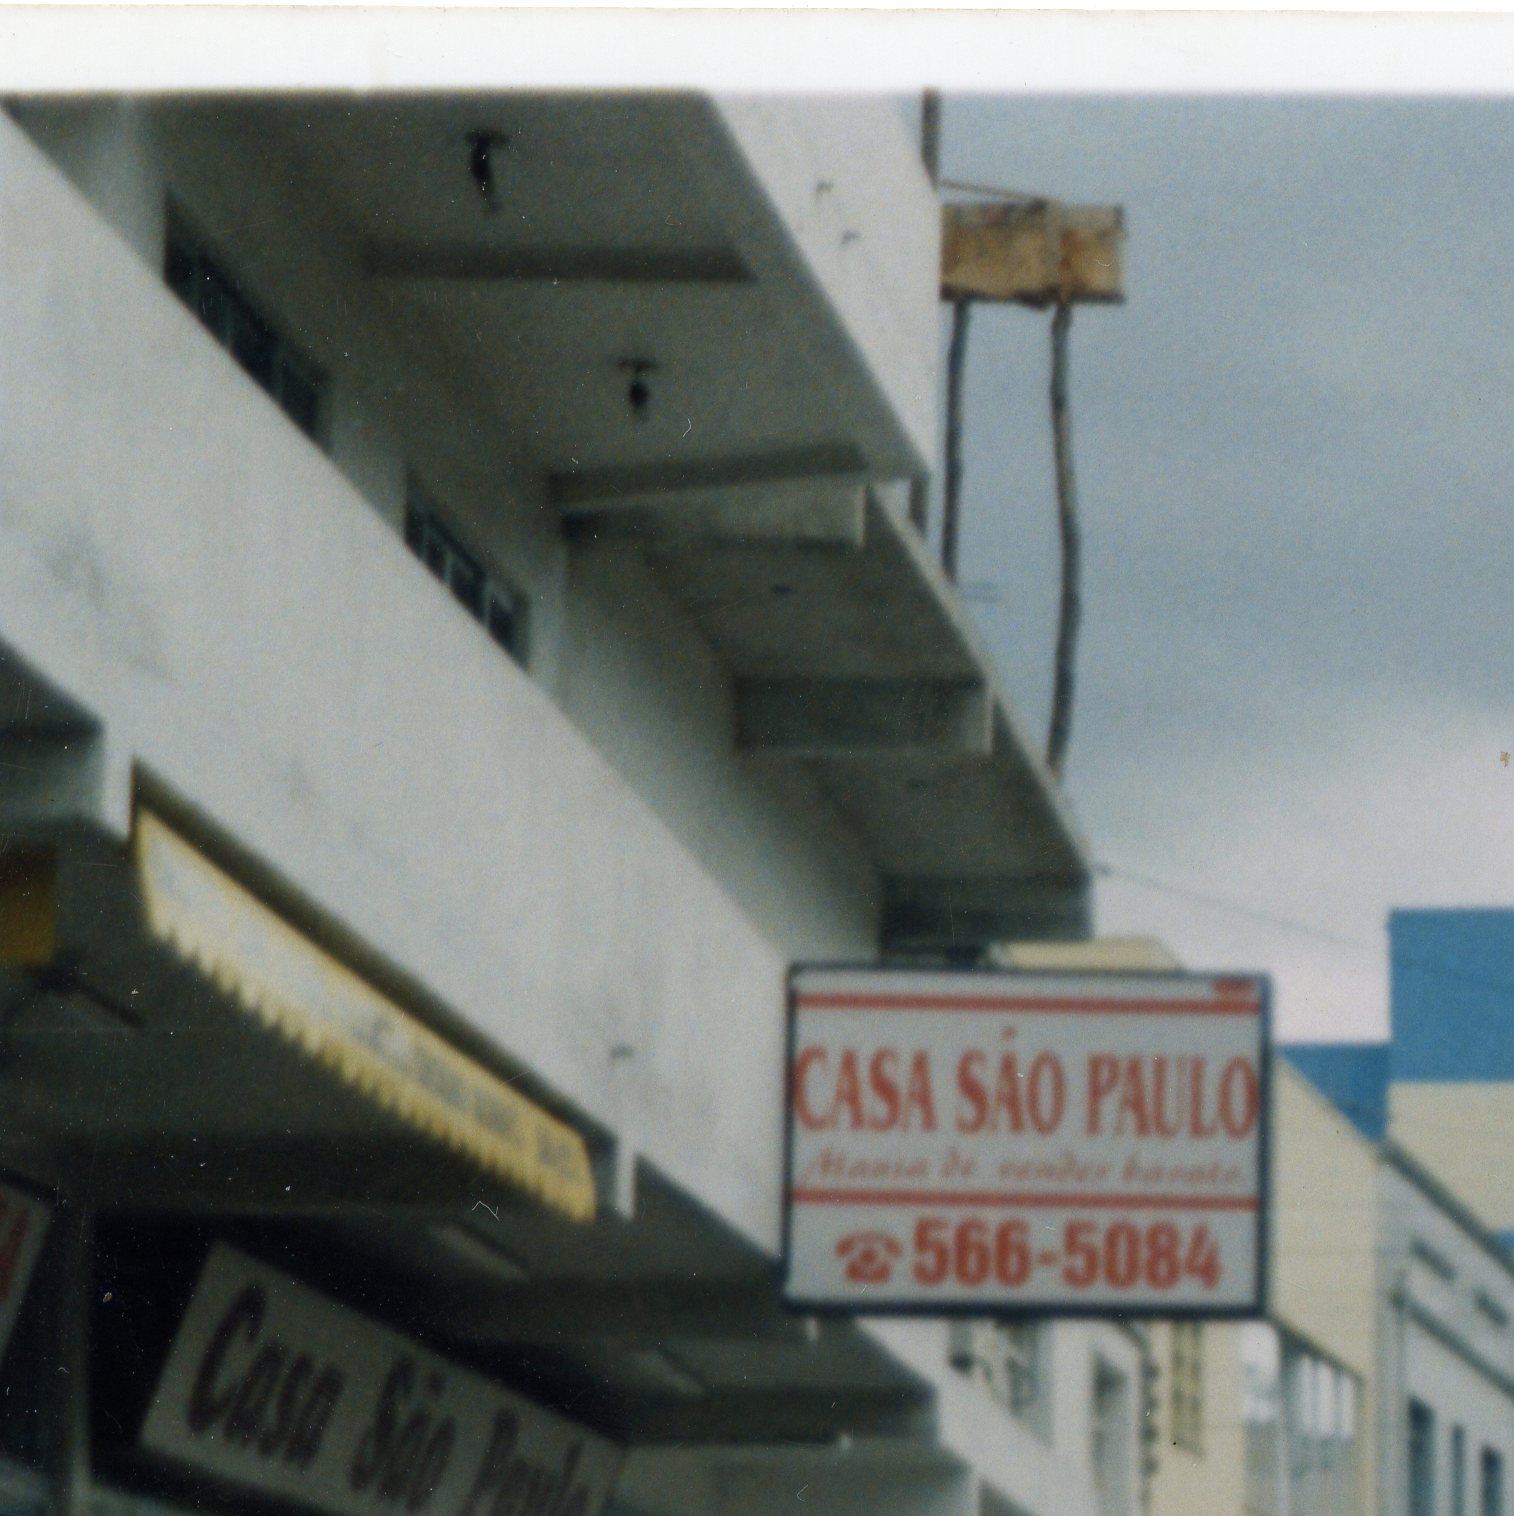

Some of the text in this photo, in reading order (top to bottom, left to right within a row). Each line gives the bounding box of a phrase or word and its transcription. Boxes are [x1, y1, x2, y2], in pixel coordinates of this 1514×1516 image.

[796, 1026, 1259, 1140] CASA SÃO PAULO
[912, 1217, 1221, 1290] 566-5084
[187, 1284, 346, 1472] Casa
[346, 1355, 457, 1515] São
